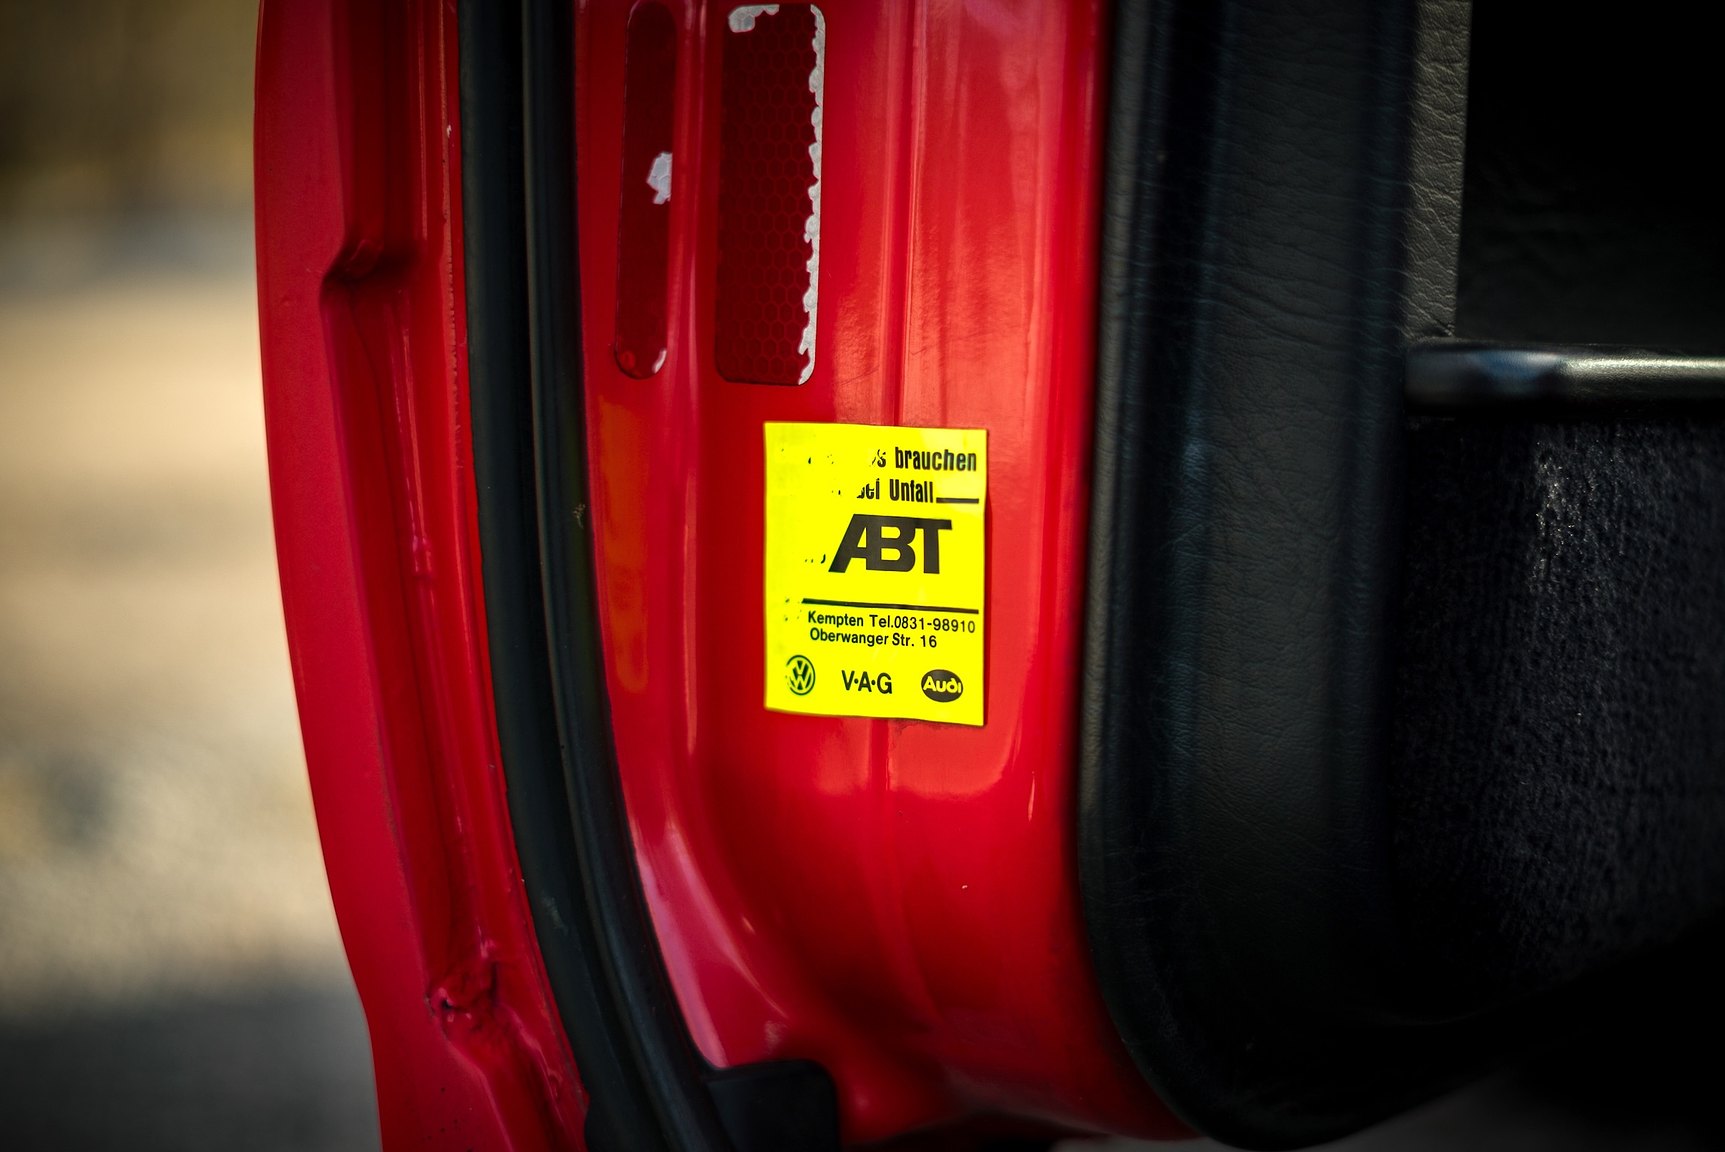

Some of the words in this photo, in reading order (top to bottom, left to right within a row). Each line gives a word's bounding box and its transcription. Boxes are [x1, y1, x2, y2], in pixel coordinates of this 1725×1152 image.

[895, 446, 977, 472] brauchen
[889, 478, 934, 504] Unfall
[828, 513, 953, 575] ABT
[808, 610, 864, 628] Kempten
[810, 627, 889, 647] Oberwanger
[892, 632, 915, 647] Str.
[920, 634, 938, 648] 16
[922, 675, 963, 694] Audi
